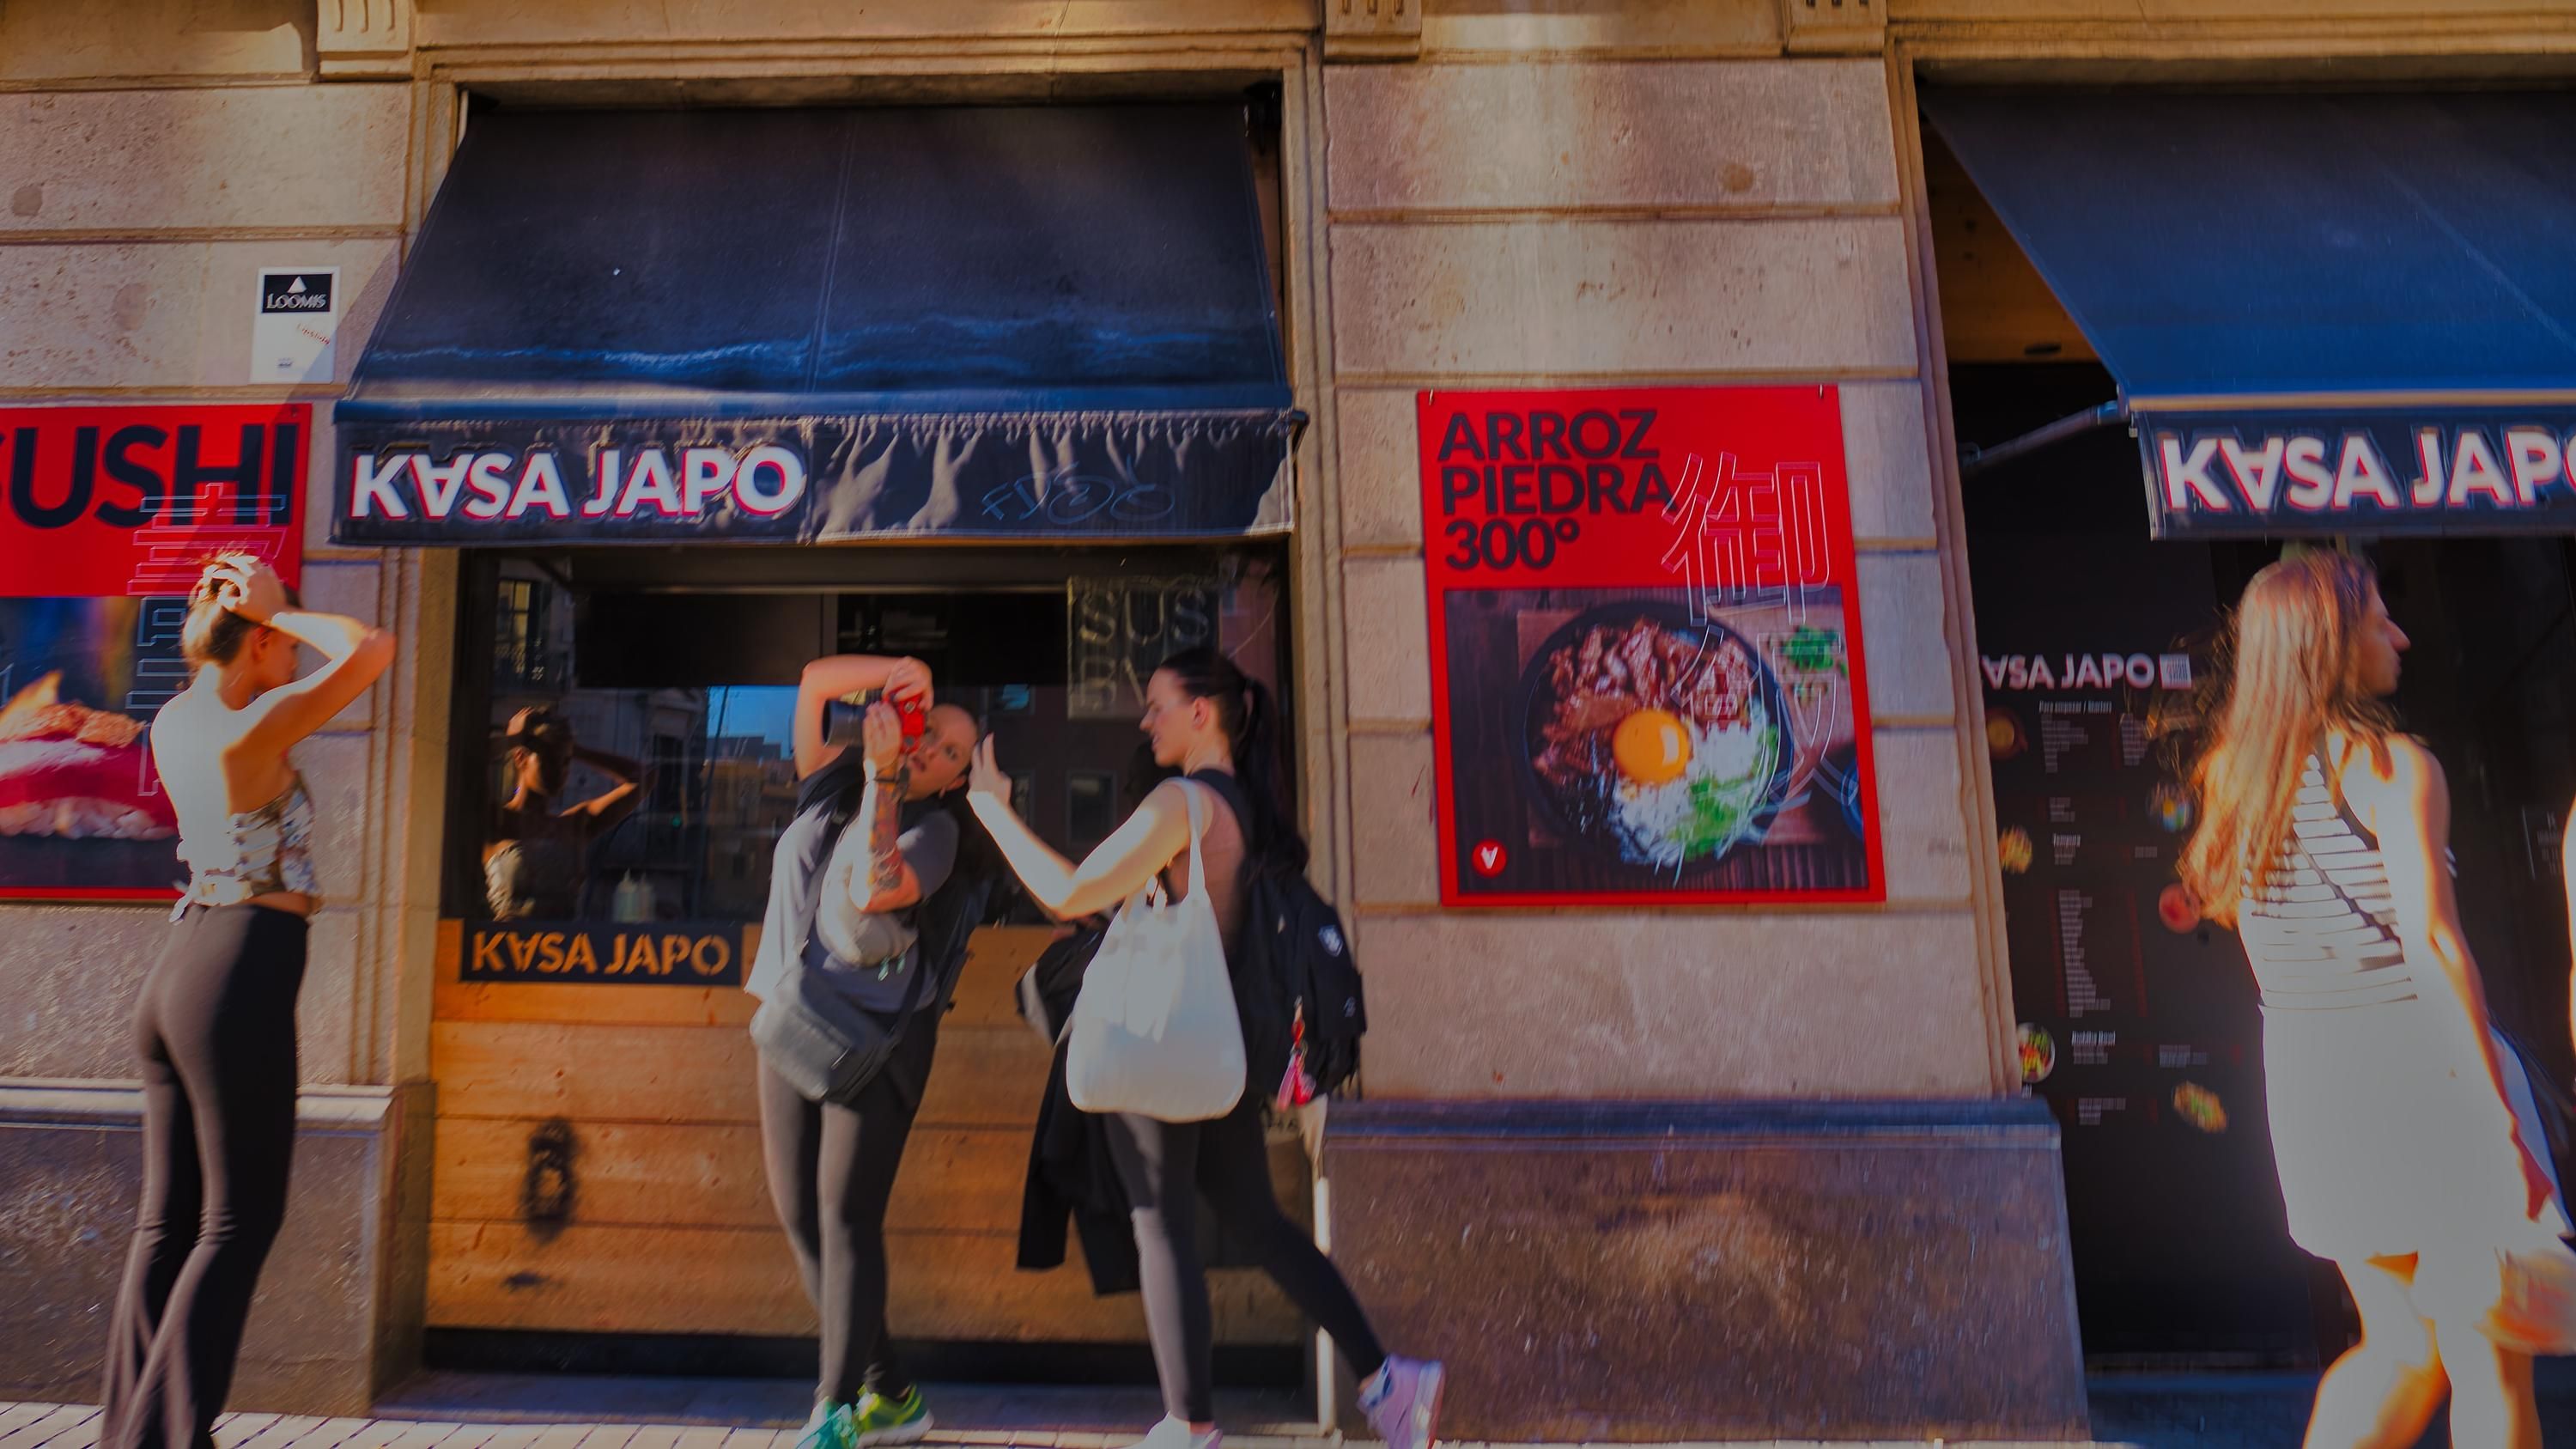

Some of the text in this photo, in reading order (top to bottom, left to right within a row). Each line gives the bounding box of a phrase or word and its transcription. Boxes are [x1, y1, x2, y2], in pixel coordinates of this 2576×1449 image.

[266, 292, 327, 310] LOOMIS
[1439, 411, 1659, 461] ARROZ
[0, 423, 298, 529] USHI
[584, 445, 805, 517] JAPO
[1442, 464, 1678, 515] PIEDRA
[1980, 654, 2056, 691] ASA
[2060, 652, 2155, 690] JAPO
[604, 933, 730, 976] JAPO
